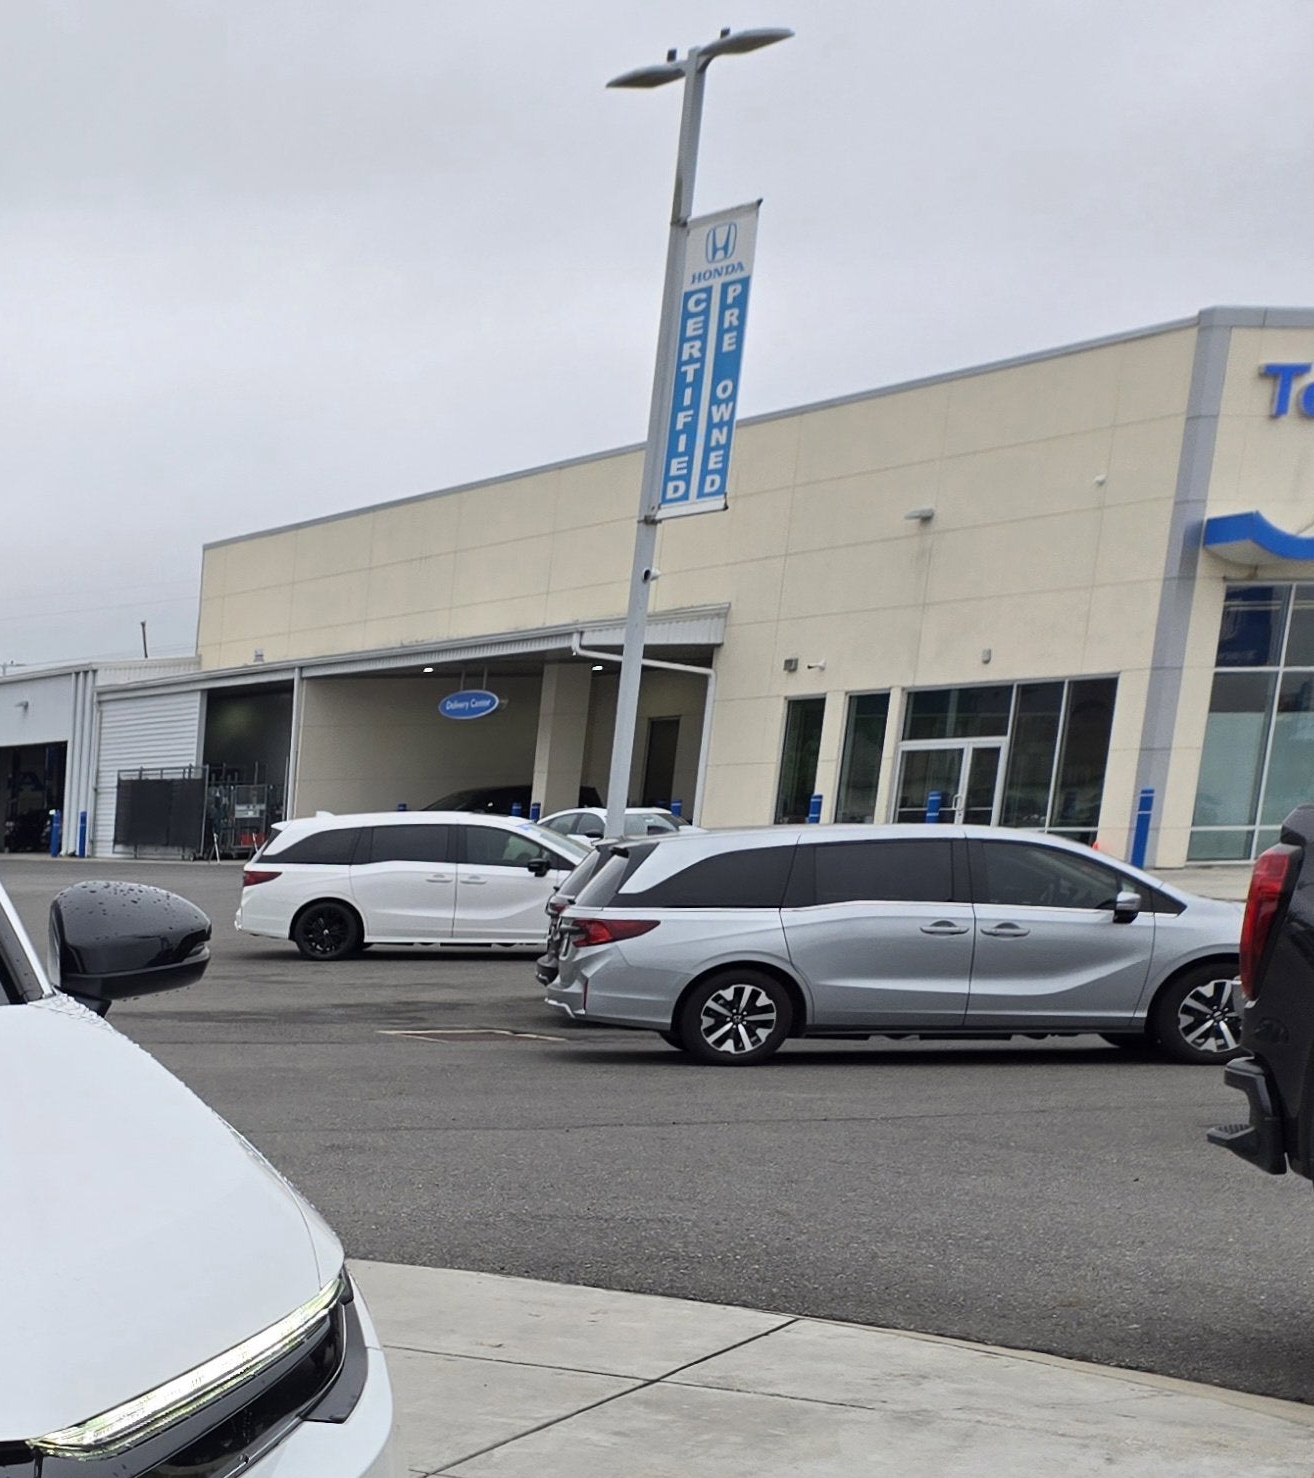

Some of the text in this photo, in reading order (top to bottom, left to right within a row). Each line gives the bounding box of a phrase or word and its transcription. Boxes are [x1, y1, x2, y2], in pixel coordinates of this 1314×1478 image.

[691, 262, 745, 285] HONDA
[665, 292, 708, 500] CERTIFIED
[704, 283, 742, 495] PRE OWNED
